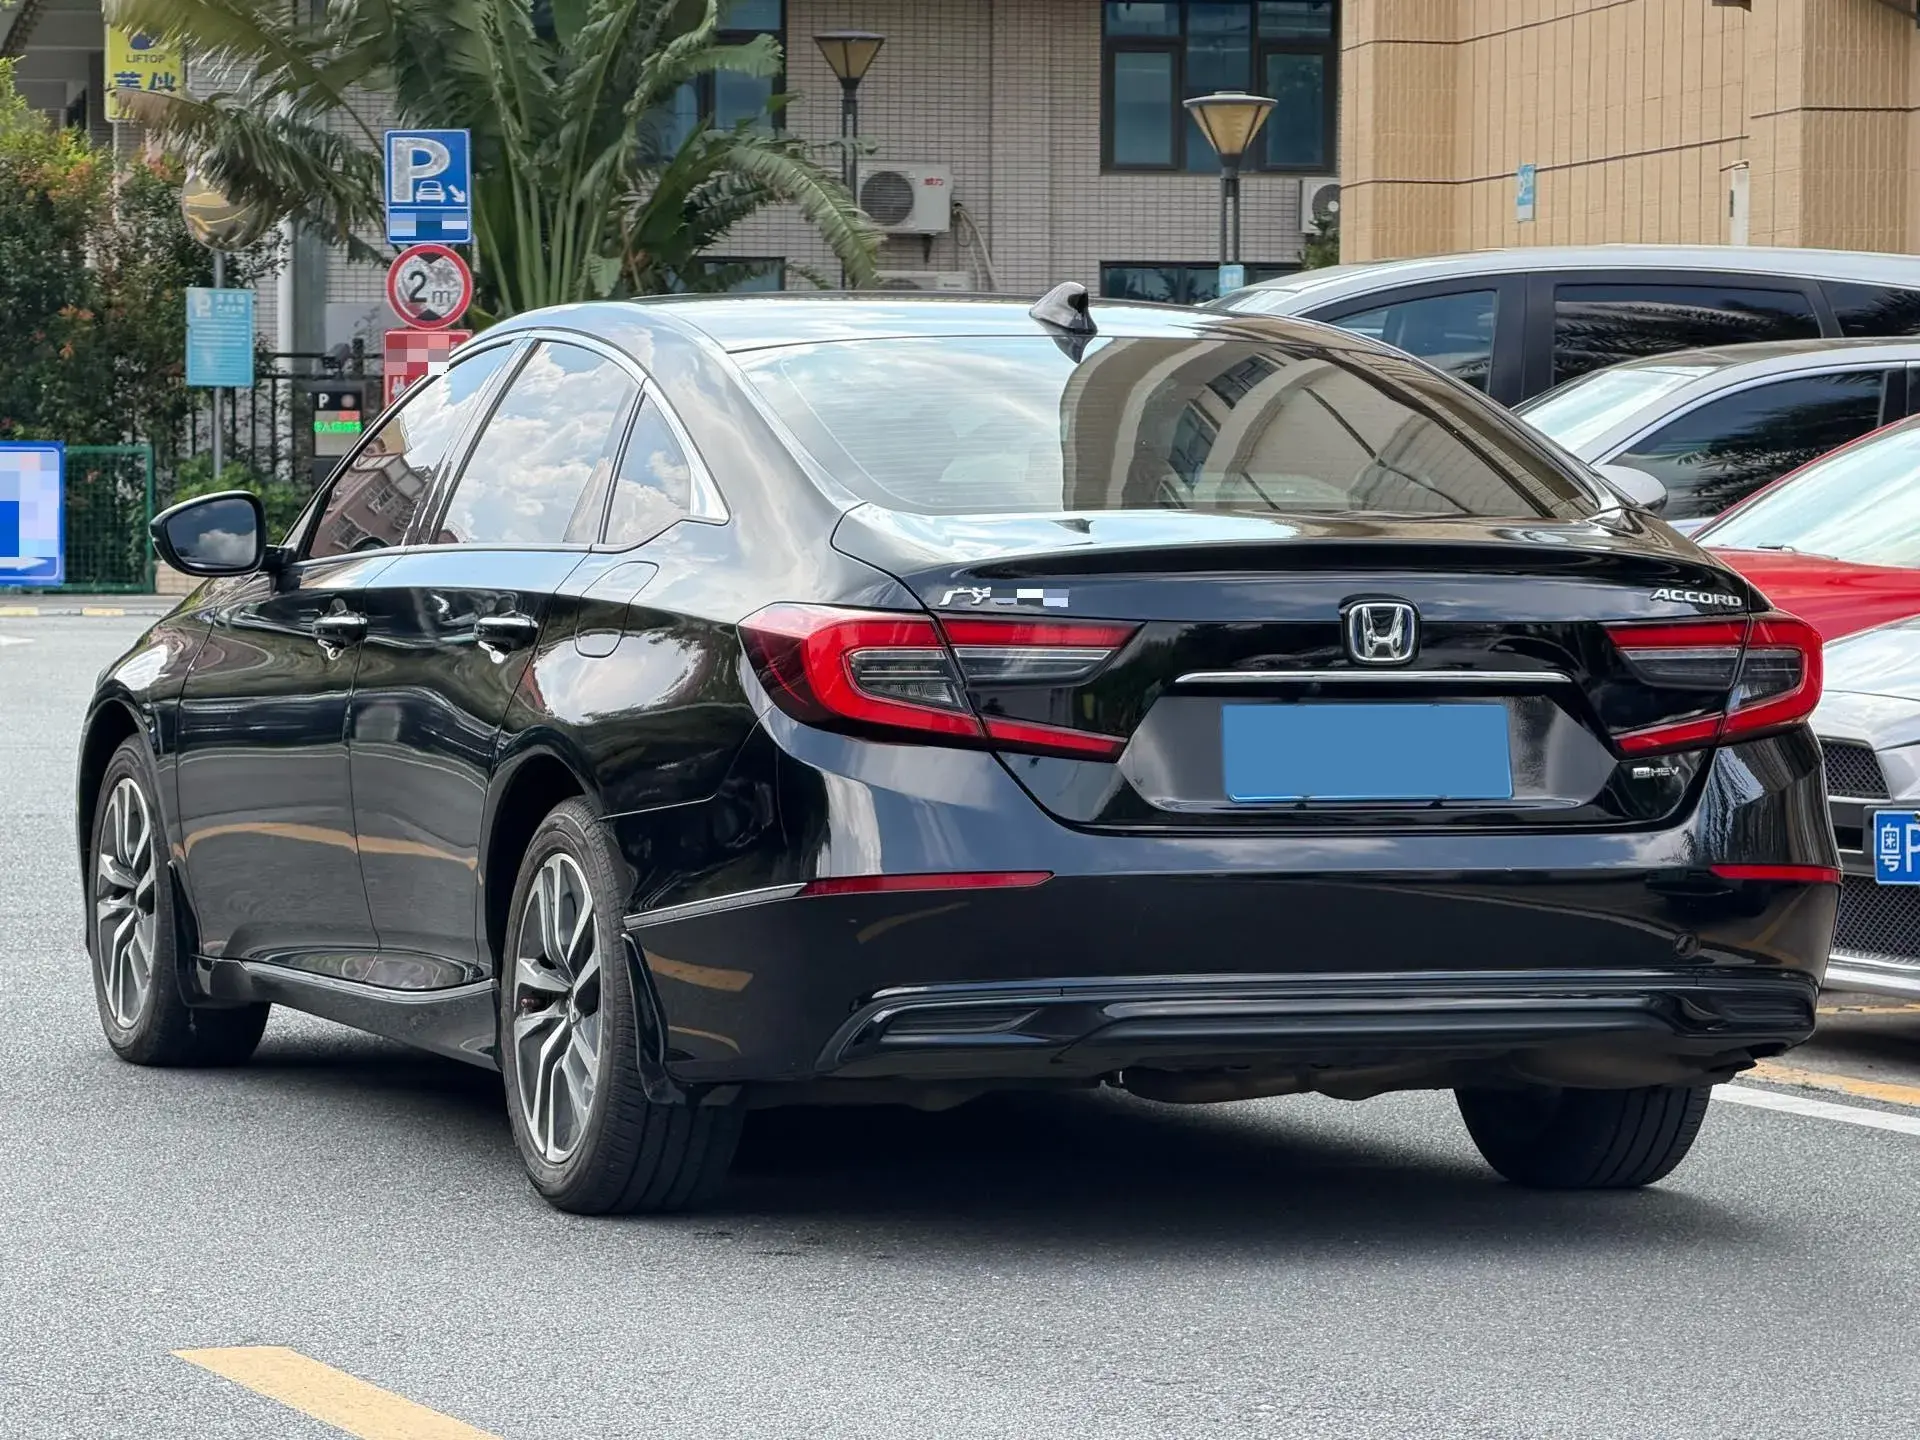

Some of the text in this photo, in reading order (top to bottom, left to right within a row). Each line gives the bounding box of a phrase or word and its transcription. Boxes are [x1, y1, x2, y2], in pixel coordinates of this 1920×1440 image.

[391, 137, 450, 202] P
[318, 393, 330, 409] P
[1650, 588, 1742, 607] ACCORD
